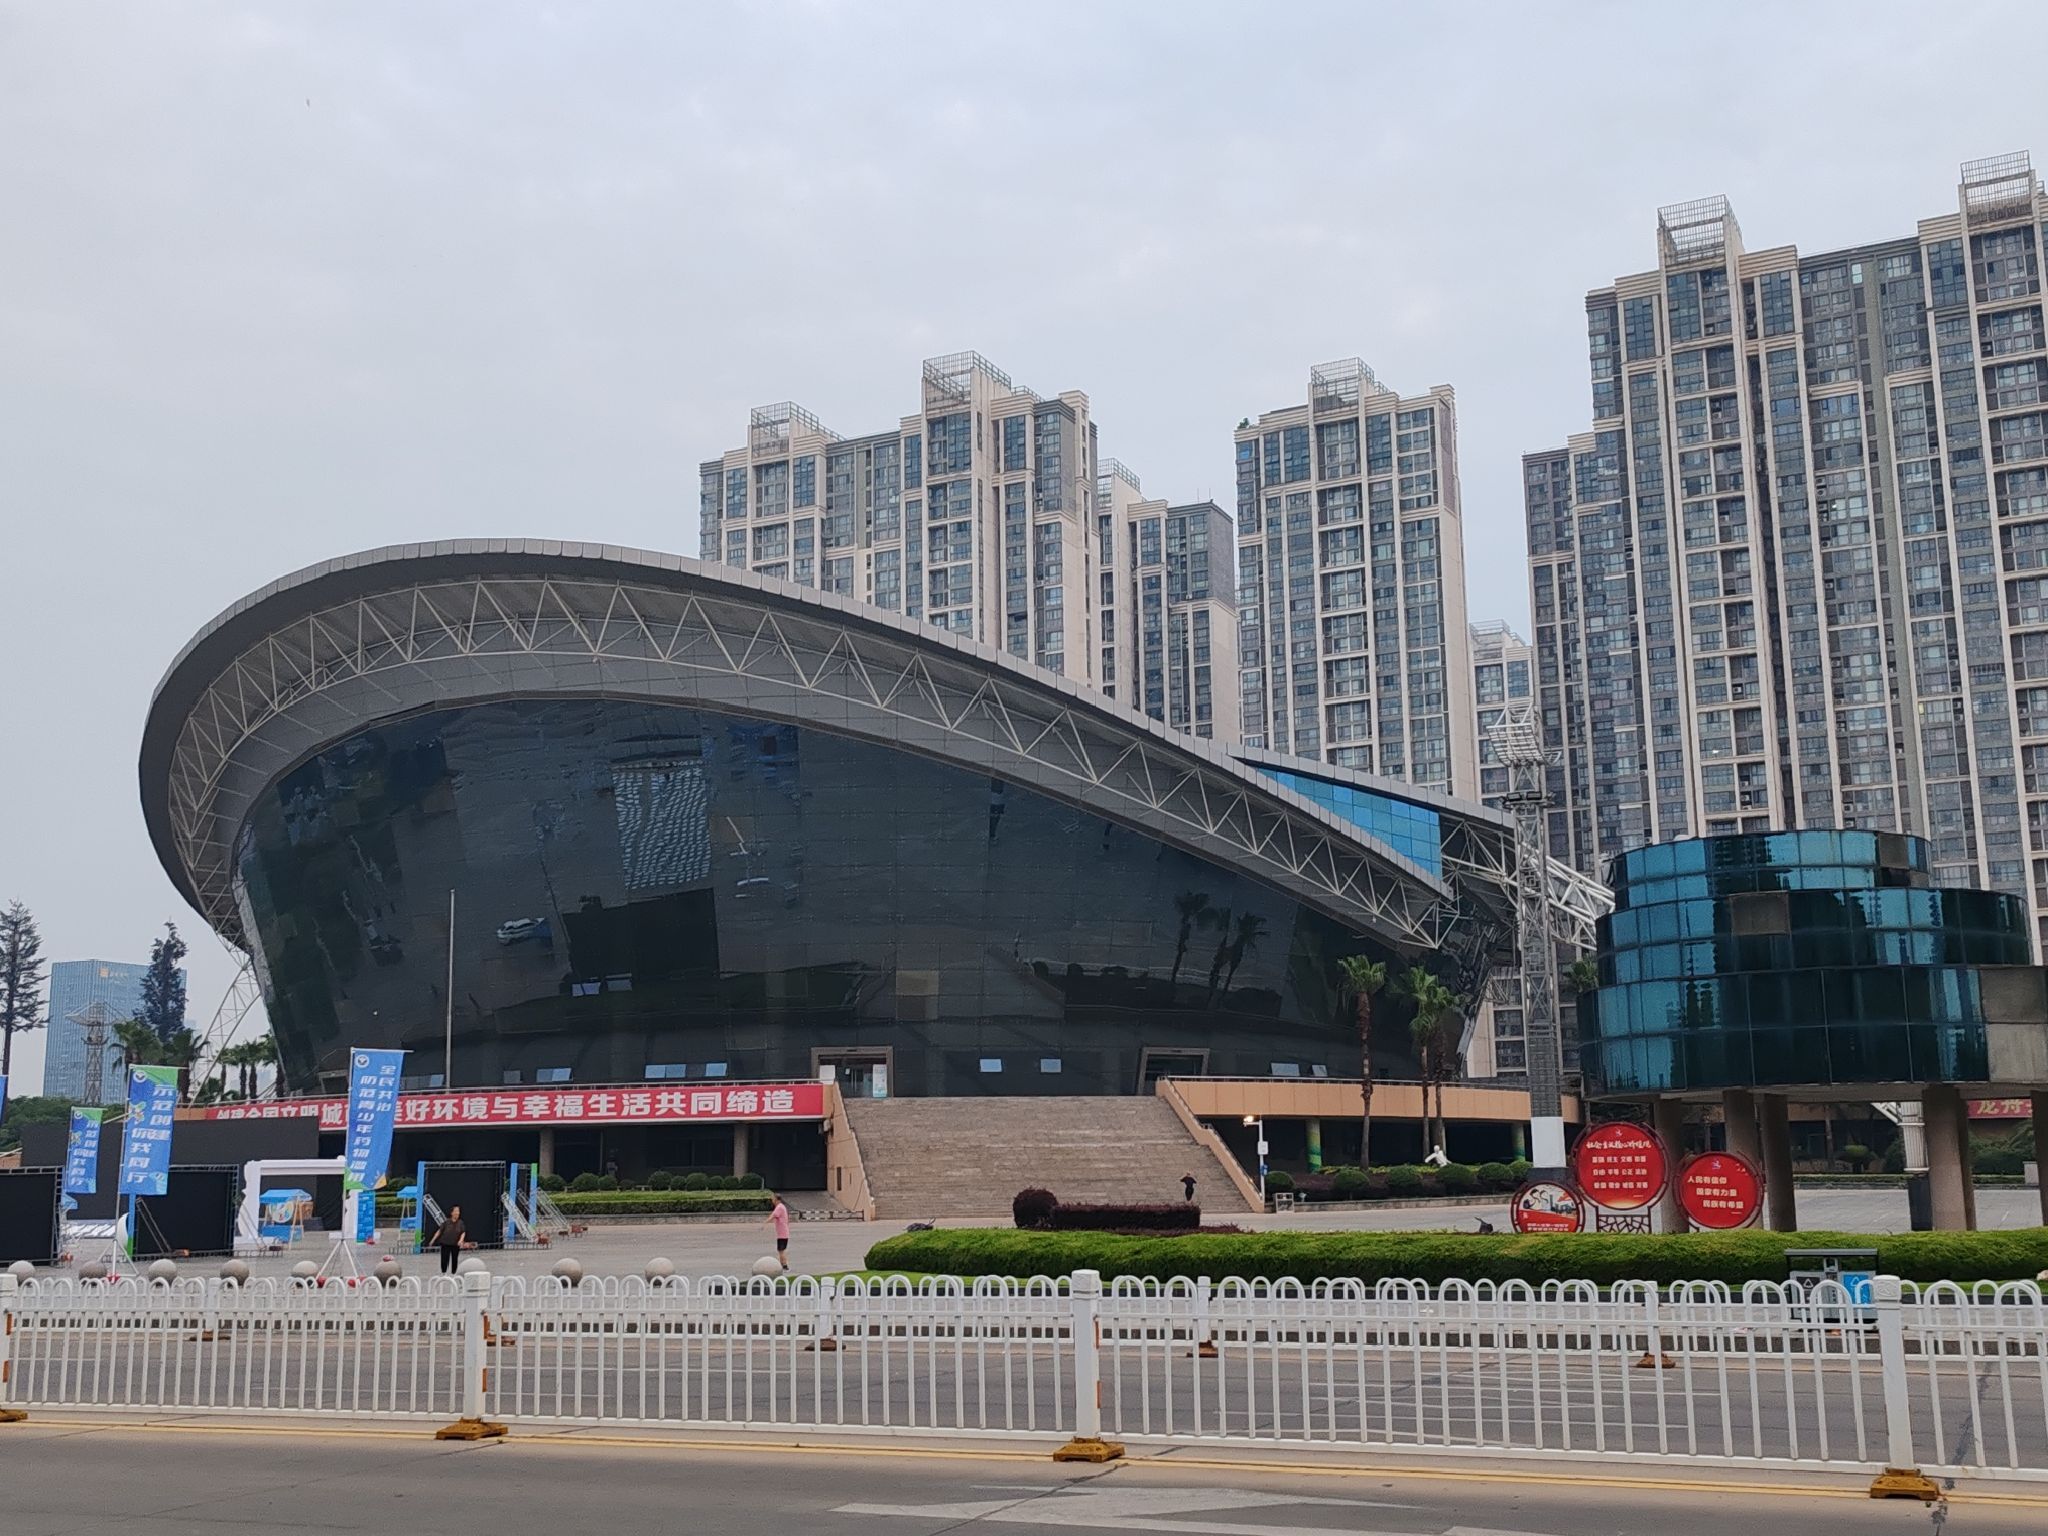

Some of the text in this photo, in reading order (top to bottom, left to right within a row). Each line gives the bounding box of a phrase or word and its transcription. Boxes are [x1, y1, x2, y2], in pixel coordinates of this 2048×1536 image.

[148, 1084, 175, 1140] 示范创建
[376, 1065, 397, 1112] 全民共治
[347, 1075, 377, 1182] 防范青少年药物滥用
